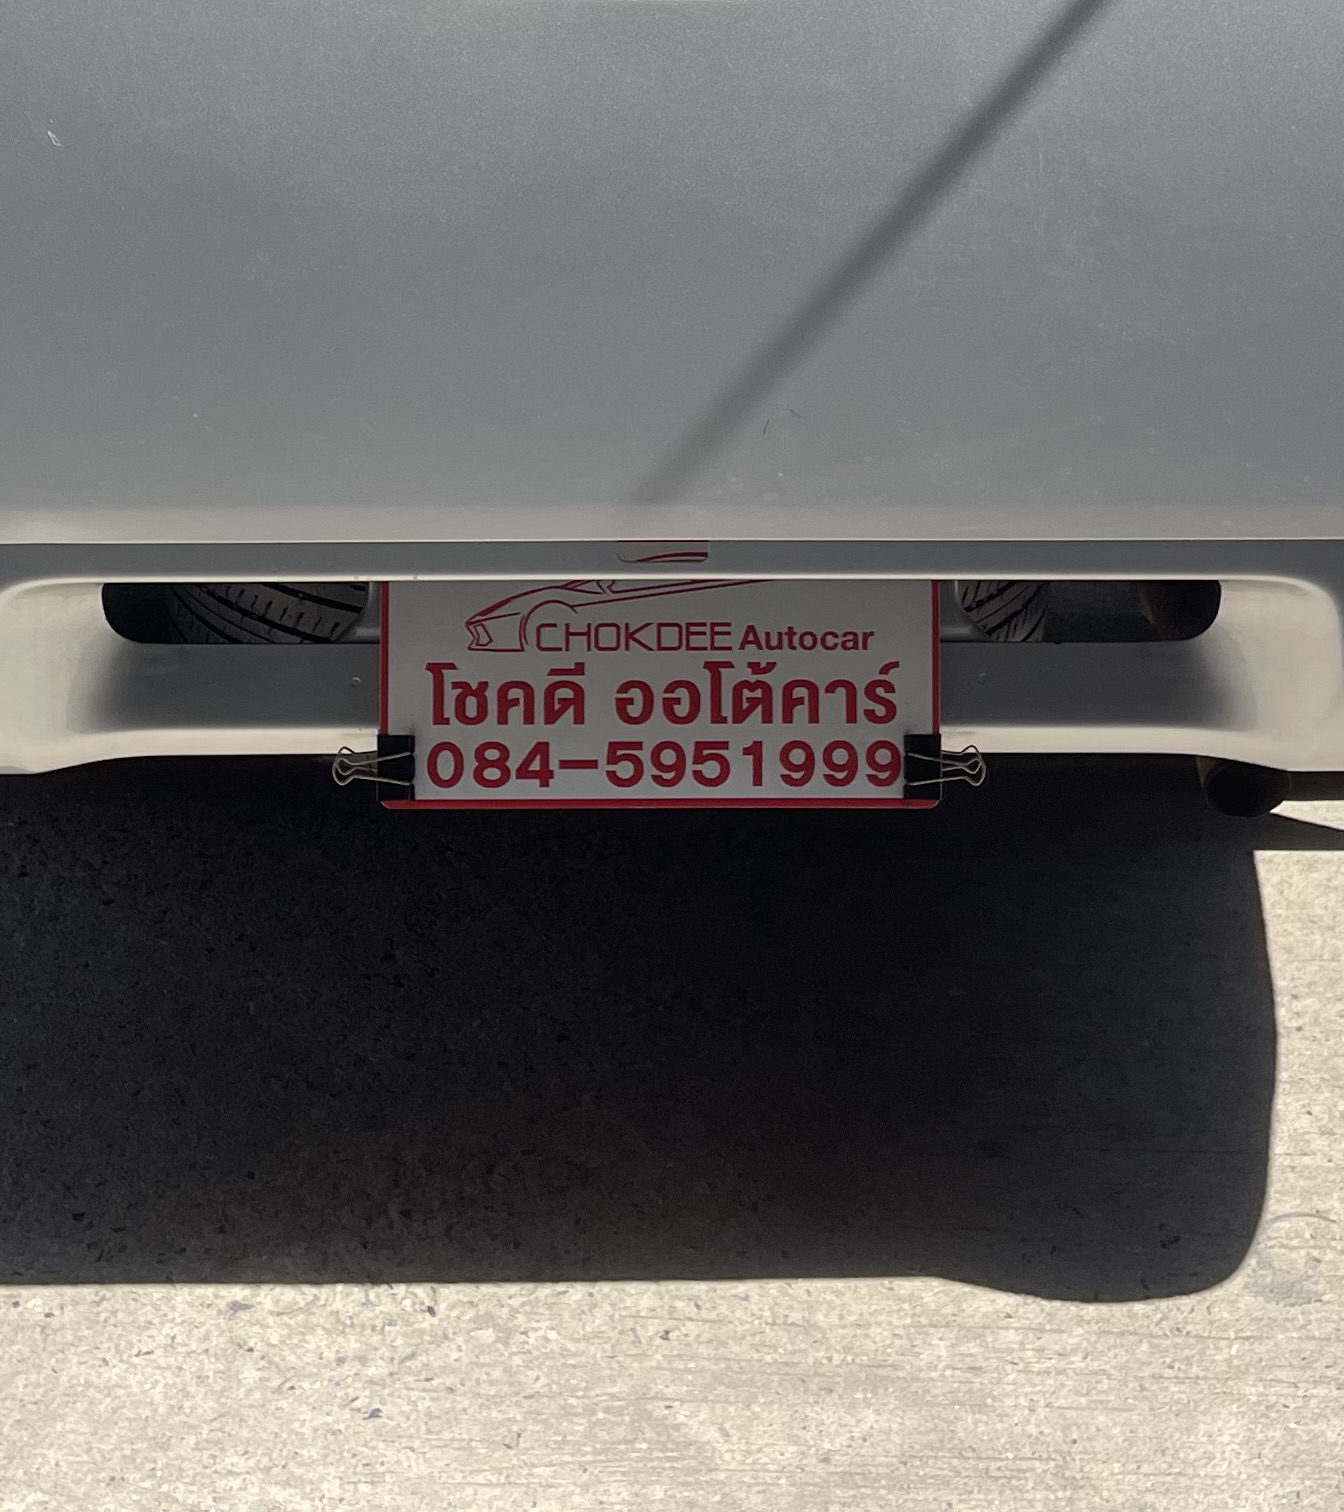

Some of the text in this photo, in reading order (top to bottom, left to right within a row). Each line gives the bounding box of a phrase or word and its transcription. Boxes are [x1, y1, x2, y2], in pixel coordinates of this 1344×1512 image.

[535, 622, 876, 652] CHOKDEE Autocar
[425, 660, 900, 726] โชคดี ออโต้คาร์
[425, 739, 903, 789] 084-5951999
